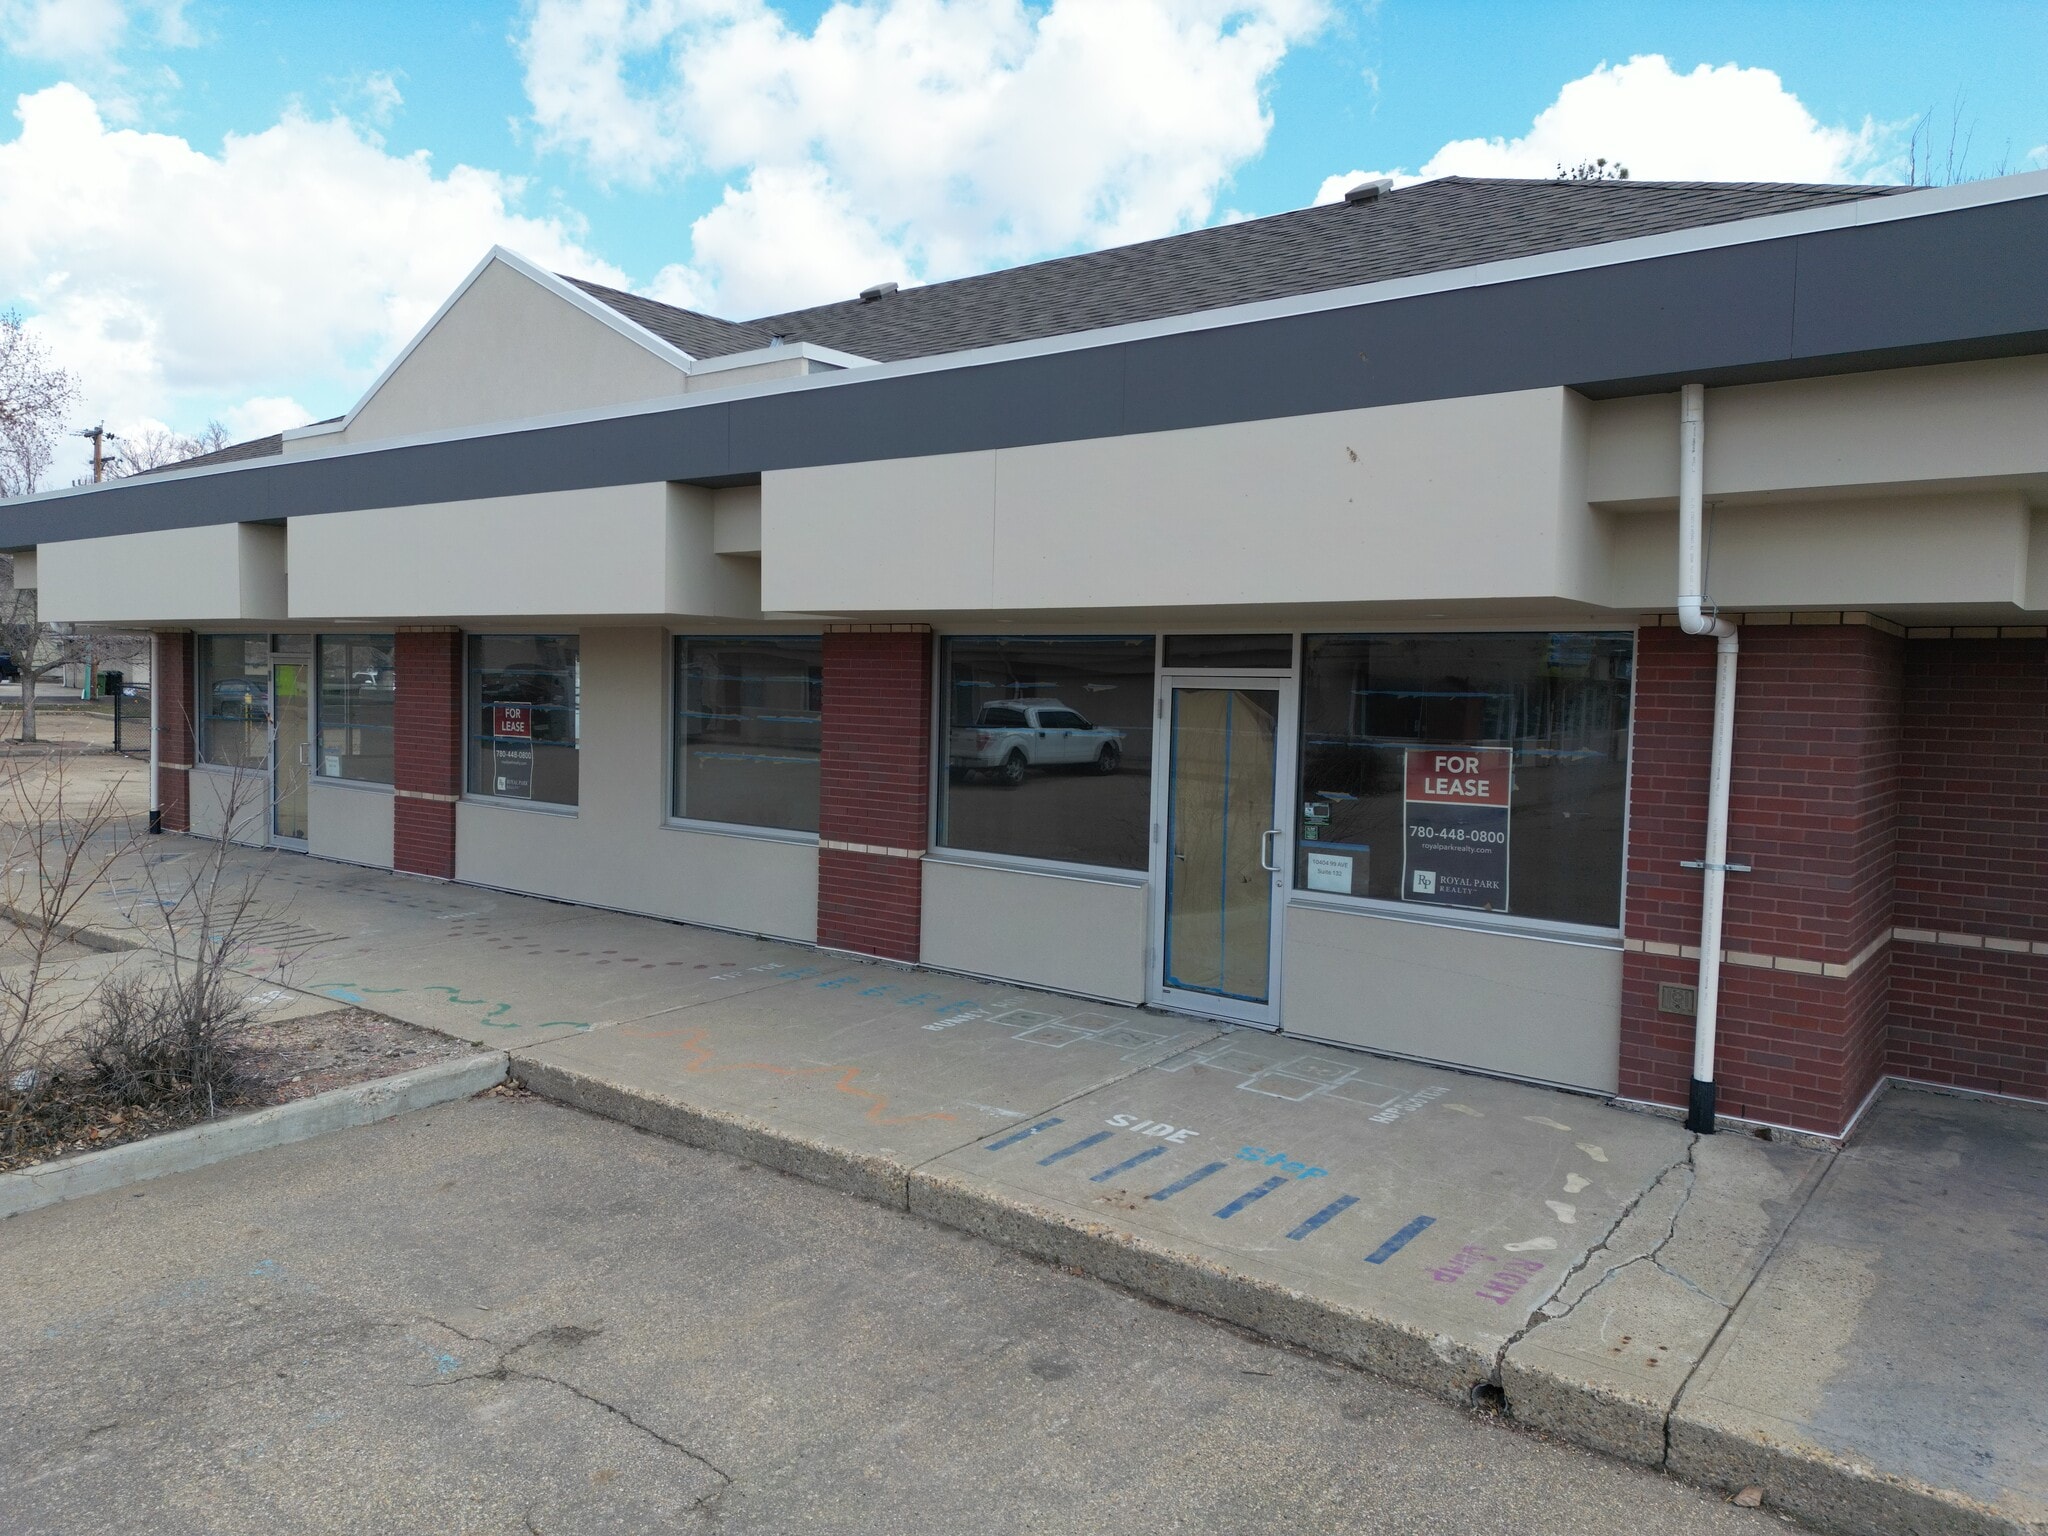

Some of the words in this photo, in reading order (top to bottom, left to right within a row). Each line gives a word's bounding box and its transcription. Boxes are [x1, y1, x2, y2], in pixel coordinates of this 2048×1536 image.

[505, 708, 521, 718] FOR
[501, 721, 525, 732] LEASE
[1435, 756, 1479, 774] FOR
[1425, 778, 1490, 797] LEASE
[1409, 825, 1505, 844] 780-448-0800
[1421, 843, 1492, 854] royalparkrealty.com
[1440, 875, 1472, 887] ROYAL
[1474, 879, 1500, 890] PARK
[1104, 1113, 1200, 1145] SIDE
